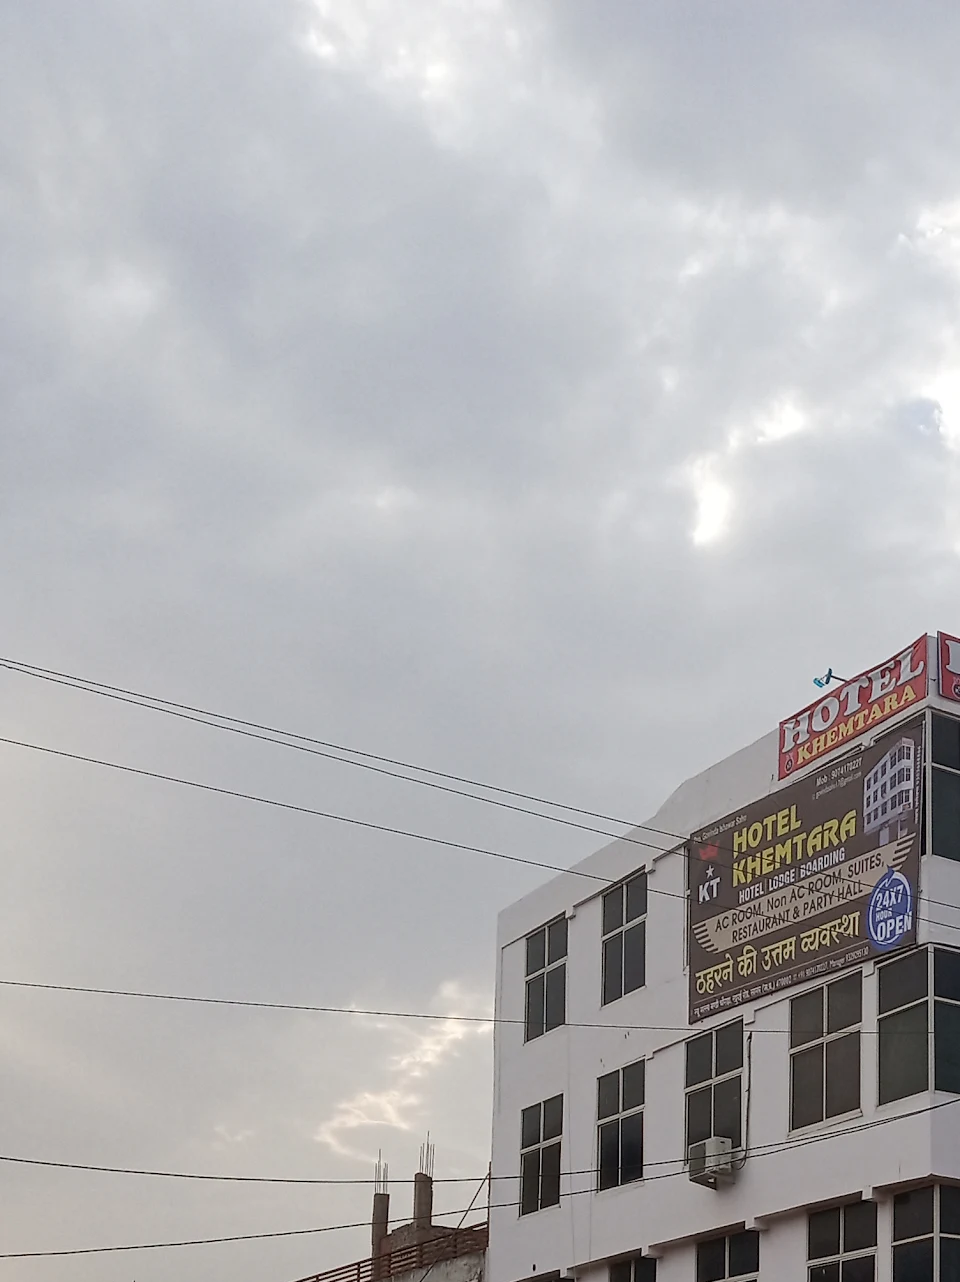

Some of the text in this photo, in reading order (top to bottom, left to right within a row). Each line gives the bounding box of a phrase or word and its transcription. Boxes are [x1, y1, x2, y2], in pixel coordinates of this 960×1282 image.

[782, 647, 925, 753] HOTEL
[797, 685, 917, 765] KHEMTARA
[732, 809, 857, 888] KHEMTARA
[733, 804, 802, 859] HOTEL
[698, 877, 721, 905] KT
[714, 916, 730, 933] AC
[766, 895, 787, 913] Non
[789, 887, 806, 906] AC
[848, 853, 885, 879] SUITES,
[738, 847, 846, 904] HOTEL LODGE BOARDING
[732, 879, 863, 943] RESTAURANT & PARTY HALL
[875, 908, 893, 922] HOUR
[877, 911, 912, 941] OPEN
[695, 911, 861, 994] ठहरने की उत्तम व्यवस्था
